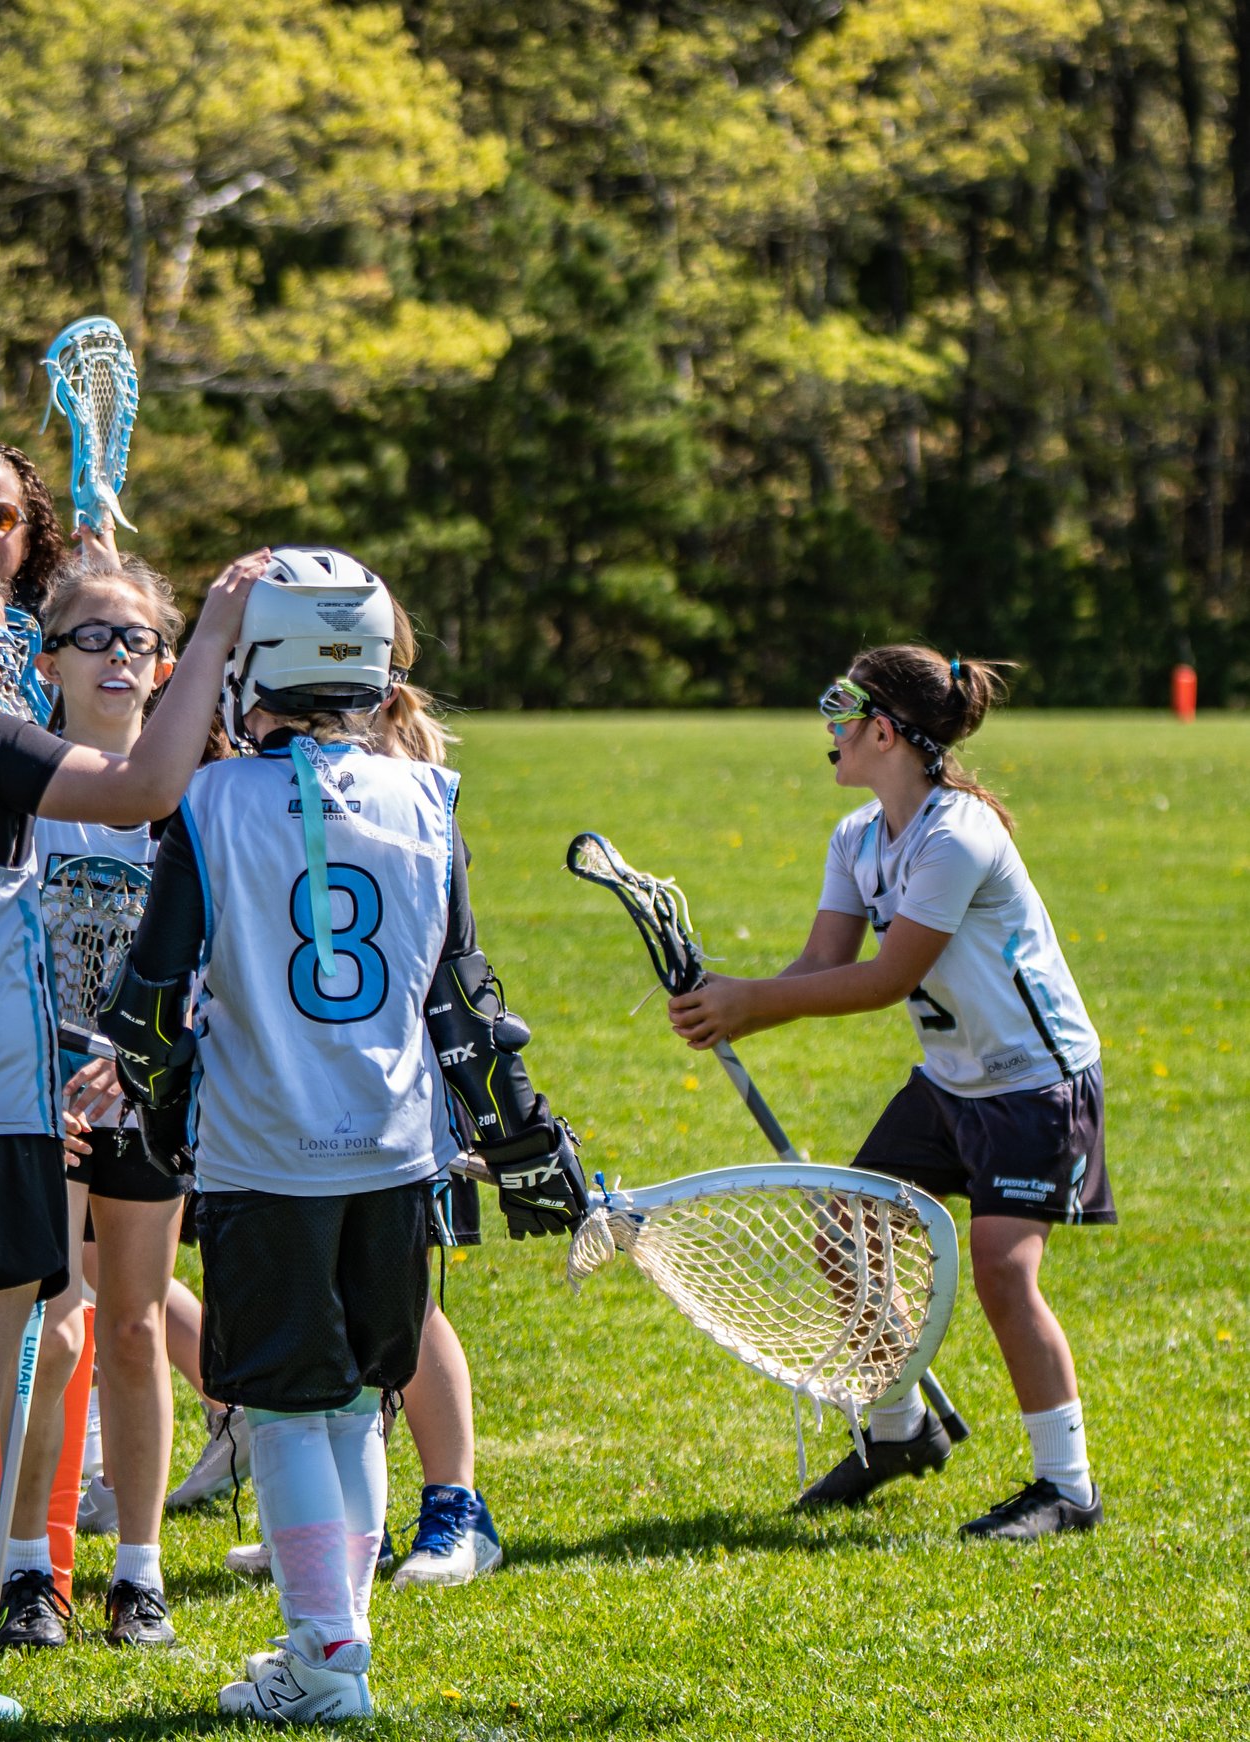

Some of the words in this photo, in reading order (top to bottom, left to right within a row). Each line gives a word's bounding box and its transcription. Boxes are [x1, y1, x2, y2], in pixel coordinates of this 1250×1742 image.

[287, 862, 390, 1025] 8
[439, 1042, 478, 1067] STX
[478, 1113, 497, 1127] 200
[299, 1138, 339, 1151] LONG
[345, 1135, 385, 1149] POINT
[501, 1156, 564, 1190] STX
[536, 1198, 566, 1209] STALLION
[18, 1336, 37, 1396] LUNAR
